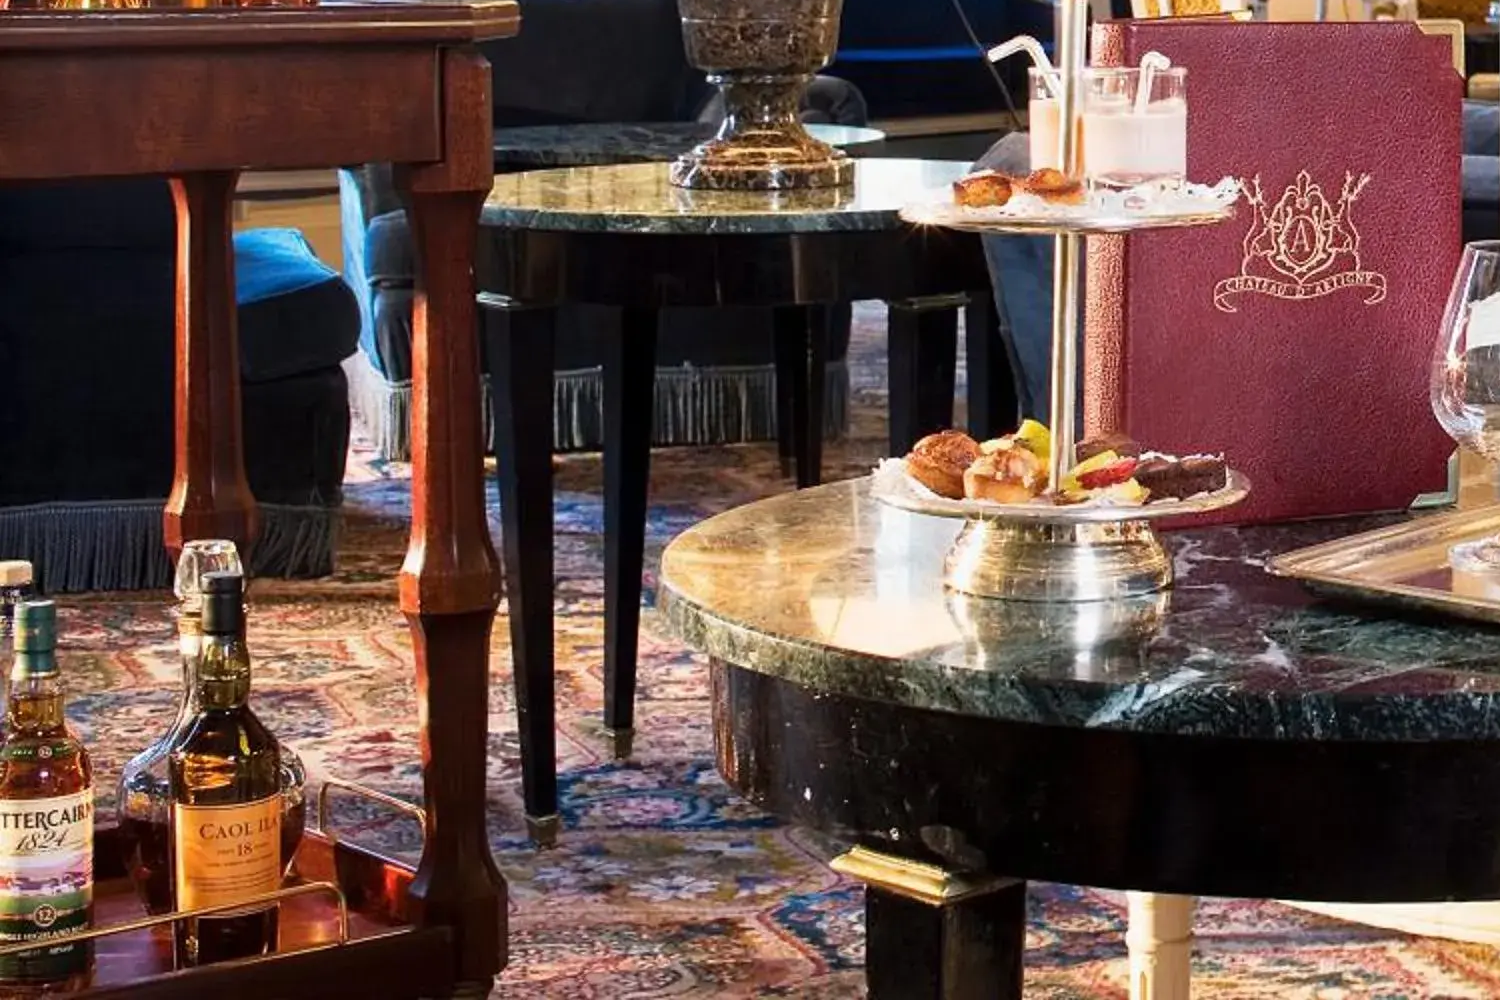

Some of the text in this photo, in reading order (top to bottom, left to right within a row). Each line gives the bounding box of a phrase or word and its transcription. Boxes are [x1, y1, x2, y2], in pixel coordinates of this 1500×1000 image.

[1291, 220, 1310, 252] A
[16, 829, 69, 850] 1824
[200, 822, 253, 841] CAOL
[237, 842, 253, 857] 18
